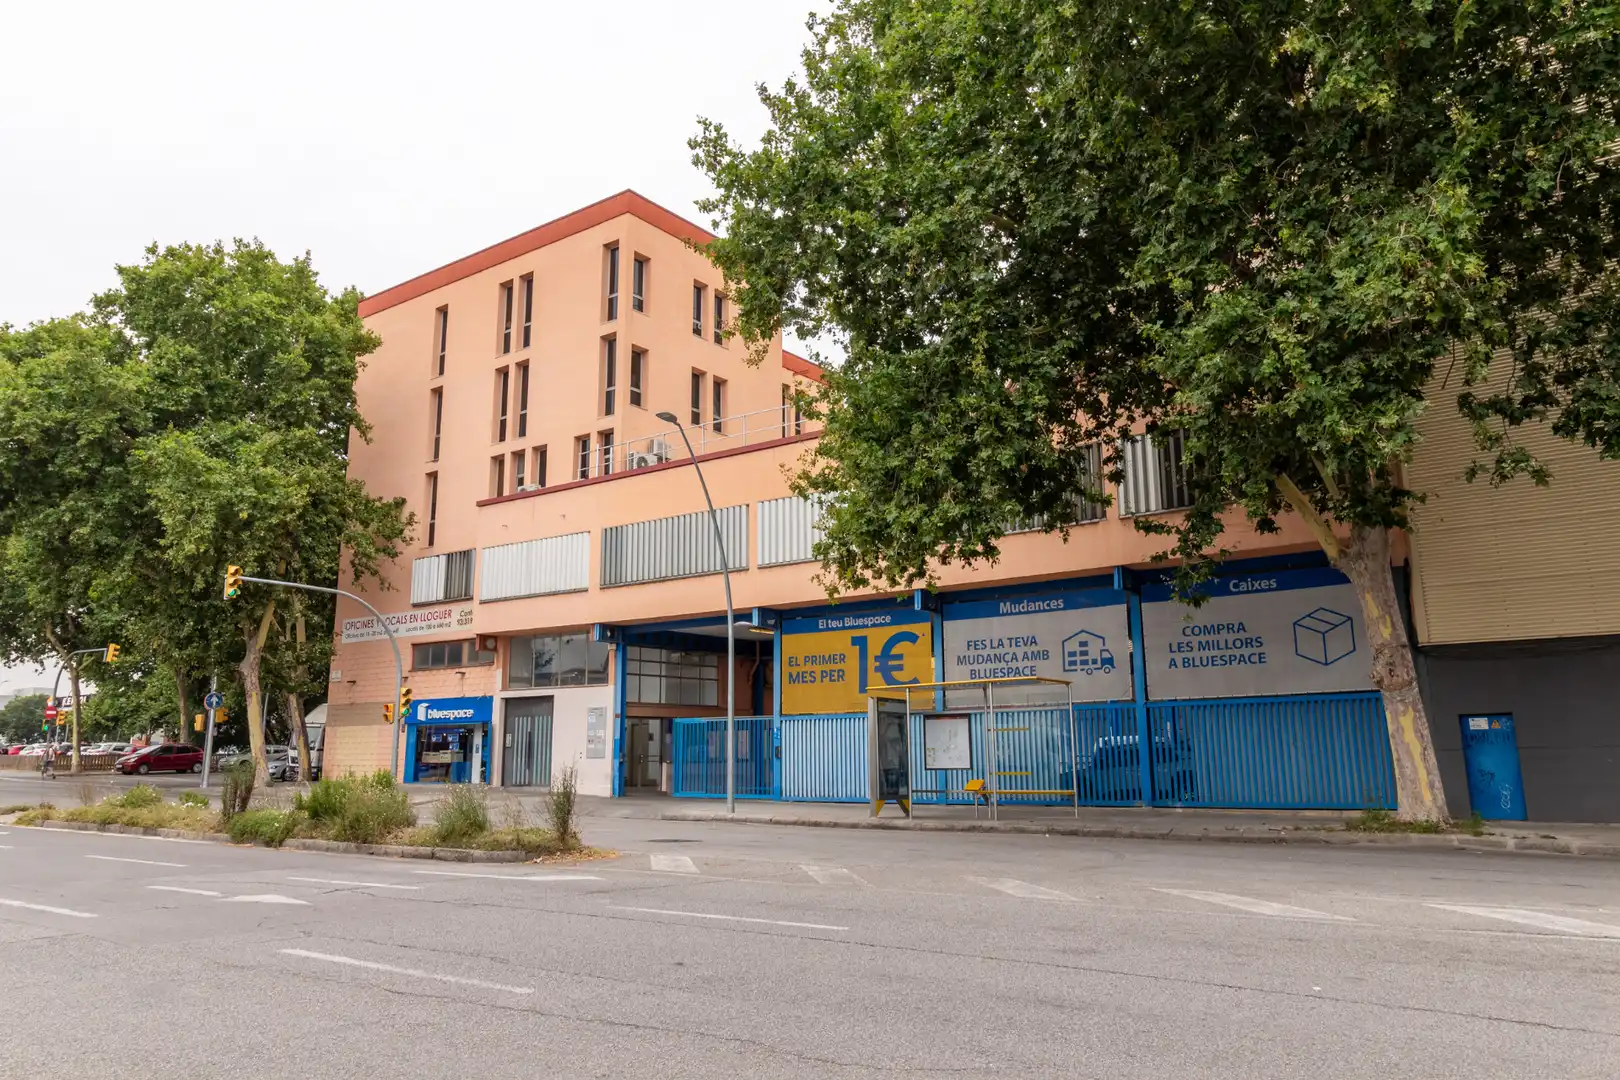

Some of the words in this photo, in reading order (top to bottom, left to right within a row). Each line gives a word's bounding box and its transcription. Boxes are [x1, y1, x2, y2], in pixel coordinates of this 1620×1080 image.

[1229, 578, 1277, 592] Caixes
[1000, 598, 1064, 614] Mudances
[345, 619, 374, 631] OFICINES
[382, 615, 408, 627] OCALS
[409, 614, 418, 624] EN
[420, 609, 452, 622] LLOGUER
[818, 619, 828, 629] El
[828, 619, 843, 628] teu
[844, 614, 892, 627] Bluespace
[1182, 622, 1247, 637] COMPRA
[967, 639, 987, 651] FES
[990, 638, 1005, 650] LA
[1007, 636, 1038, 648] TEVA
[1169, 641, 1194, 653] LES
[1198, 636, 1264, 651] MILLORS
[788, 656, 800, 667] EL
[803, 653, 846, 666] PRIMER
[956, 651, 1019, 666] MUDANÇA
[1021, 649, 1050, 662] AMB
[1168, 658, 1178, 669] A
[1182, 652, 1267, 668] BLUESPACE
[788, 670, 817, 684] MES
[820, 669, 846, 683] PER
[970, 665, 1037, 680] BLUESPACE
[427, 708, 475, 720] bluespace
